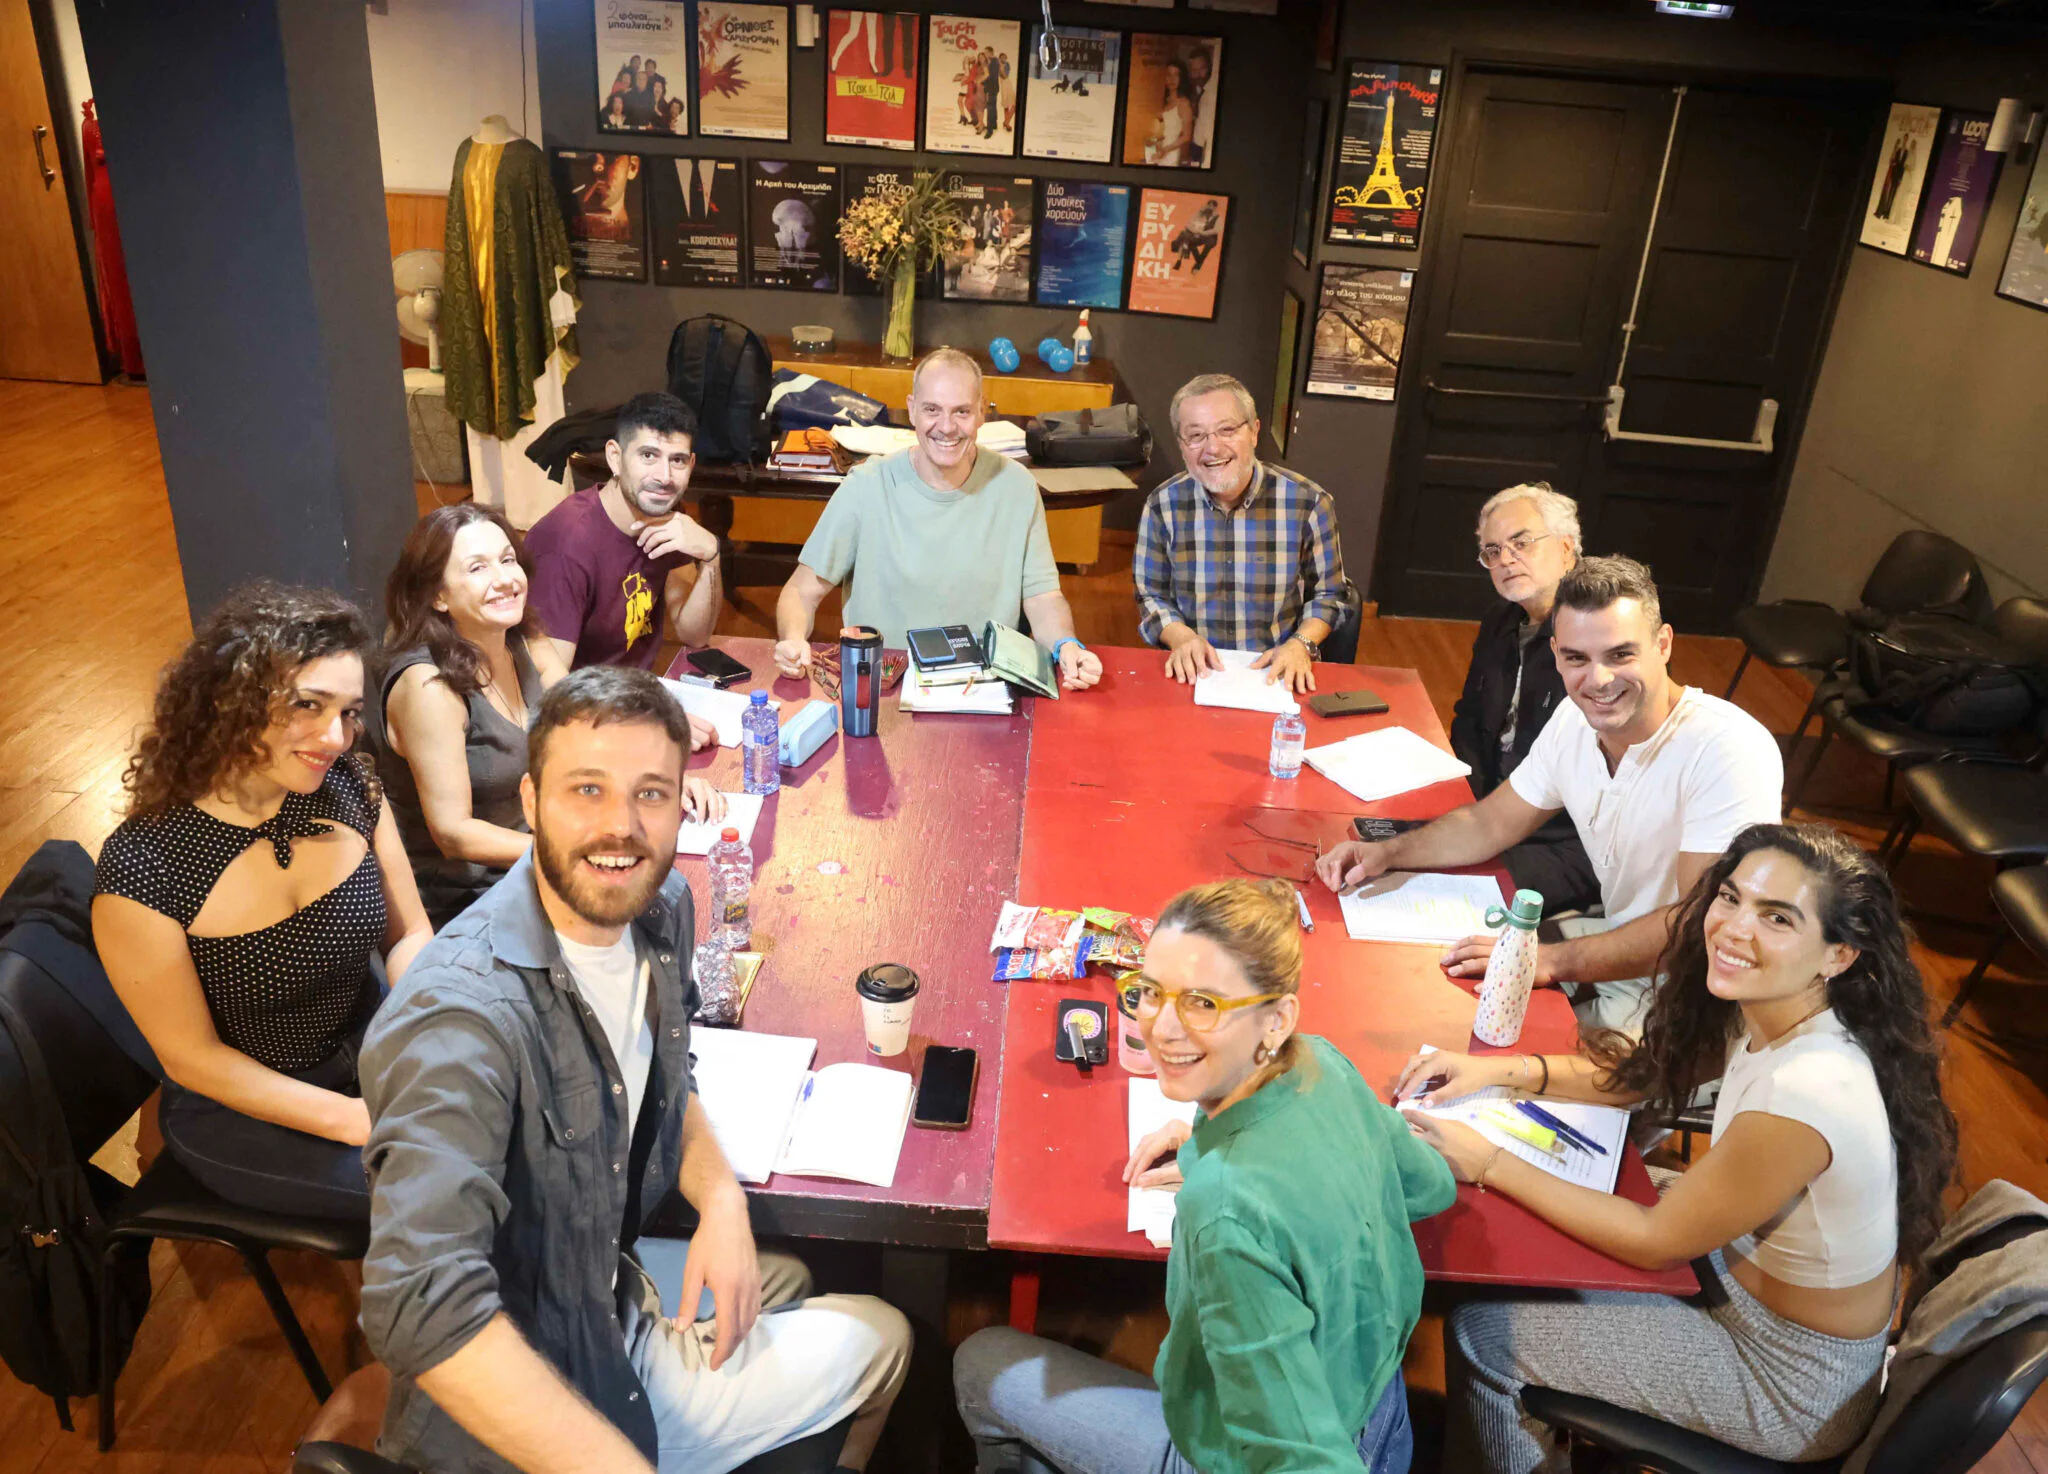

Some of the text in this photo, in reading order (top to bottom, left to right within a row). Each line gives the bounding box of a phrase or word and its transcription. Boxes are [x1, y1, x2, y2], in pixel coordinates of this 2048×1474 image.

[932, 20, 977, 38] Touch
[956, 34, 978, 50] Go
[755, 179, 762, 187] Η
[764, 180, 783, 189] Αρχή
[784, 181, 797, 189] του
[876, 173, 899, 185] ΦΩΣ
[1047, 183, 1065, 196] Δύο
[1046, 196, 1086, 210] γυναίκες
[1144, 202, 1176, 221] ΕΥ
[1045, 208, 1087, 221] χορεύουν
[1142, 221, 1175, 241] ΡΥ
[1138, 241, 1165, 259] ΔΙ
[1136, 260, 1171, 280] ΚΗ
[1005, 948, 1027, 977] HARIB
